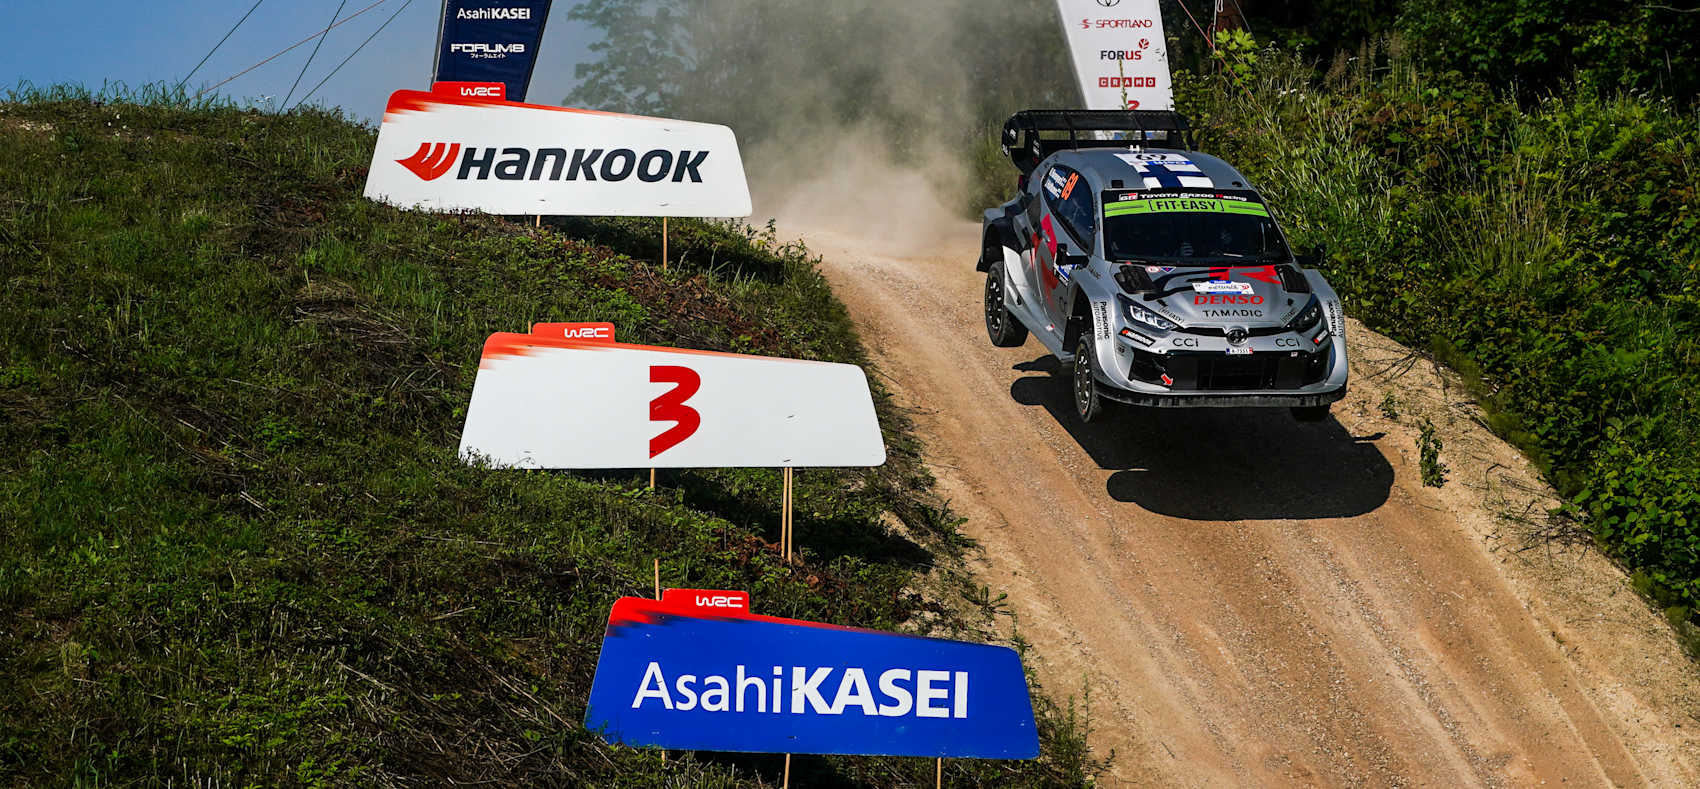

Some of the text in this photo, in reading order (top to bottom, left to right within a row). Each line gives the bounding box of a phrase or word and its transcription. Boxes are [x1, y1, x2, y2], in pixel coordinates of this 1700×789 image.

[457, 8, 531, 20] AsahiKASEI
[1096, 19, 1153, 29] SPORTLAND
[450, 43, 525, 53] FORUM8
[1100, 50, 1142, 60] FORUS
[1099, 77, 1156, 88] CRAMO
[460, 86, 501, 97] WRC
[1061, 172, 1079, 201] 69
[1215, 193, 1247, 202] Racing
[1194, 295, 1264, 305] DENSO
[1202, 309, 1263, 317] TAMADIC
[564, 327, 609, 338] WRC
[649, 365, 701, 459] 3
[695, 595, 743, 608] WRC
[631, 661, 969, 719] AsahiKASEI
